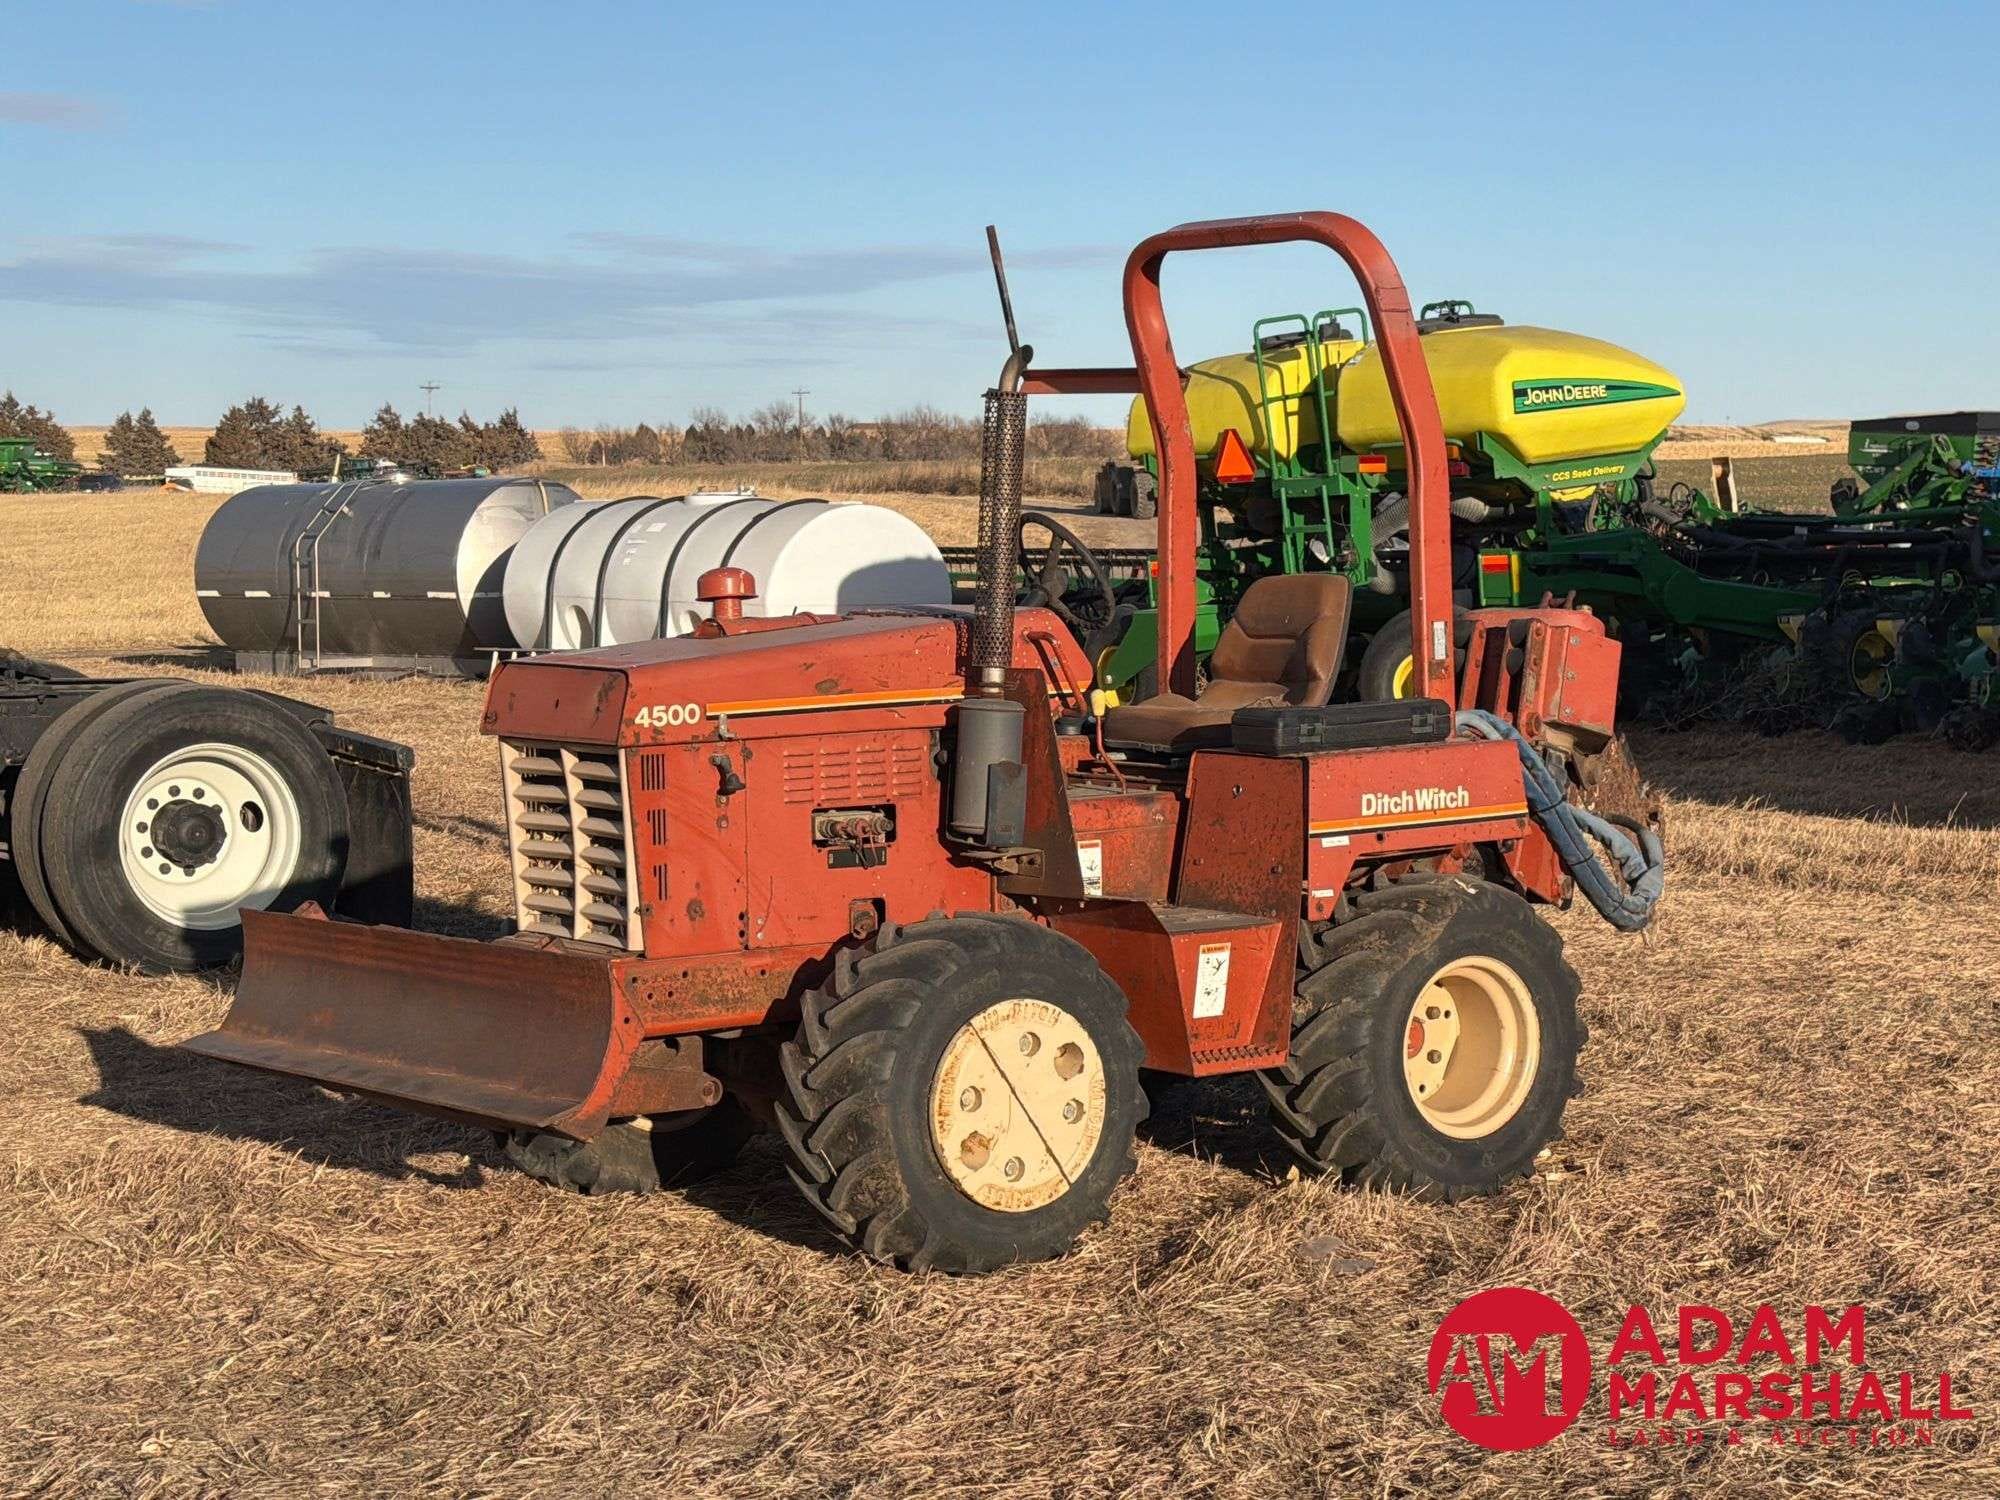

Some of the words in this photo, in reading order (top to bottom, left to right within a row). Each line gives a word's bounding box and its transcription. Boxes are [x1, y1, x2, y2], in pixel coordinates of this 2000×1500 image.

[1523, 387, 1563, 406] JOHN
[1563, 384, 1608, 401] DEERE
[1552, 471, 1570, 482] CCS
[1572, 469, 1592, 479] Seed
[1593, 464, 1625, 476] Delivery
[634, 703, 701, 728] 4500
[1361, 790, 1414, 816] Ditch
[1415, 785, 1469, 810] Witch
